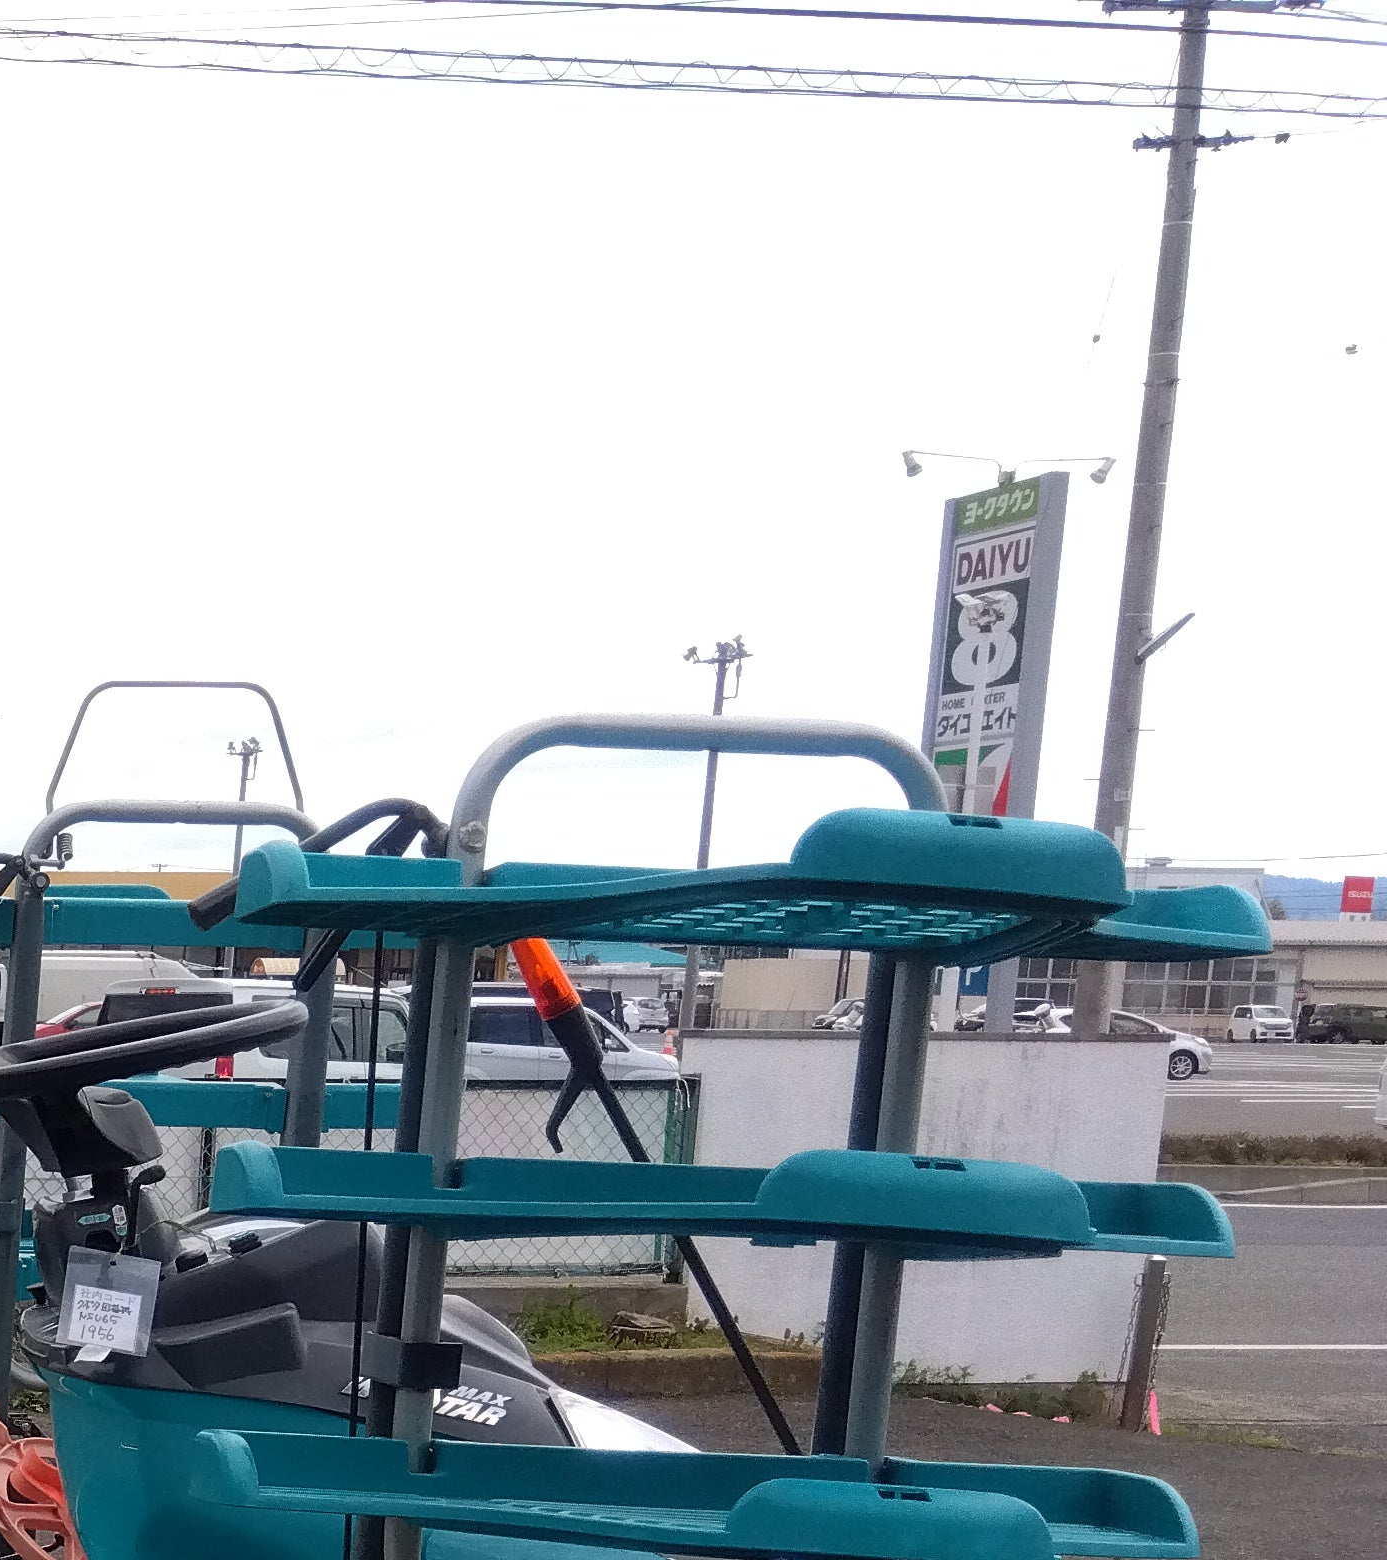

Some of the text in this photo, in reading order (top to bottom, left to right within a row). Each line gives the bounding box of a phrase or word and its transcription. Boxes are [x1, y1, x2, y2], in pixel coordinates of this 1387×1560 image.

[963, 488, 1035, 525] ヨークタウン
[956, 537, 1031, 586] DAIYU
[941, 697, 966, 711] HOME
[80, 1288, 137, 1305] 社内コード
[81, 1324, 115, 1341] 1956
[448, 1385, 513, 1407] MAX
